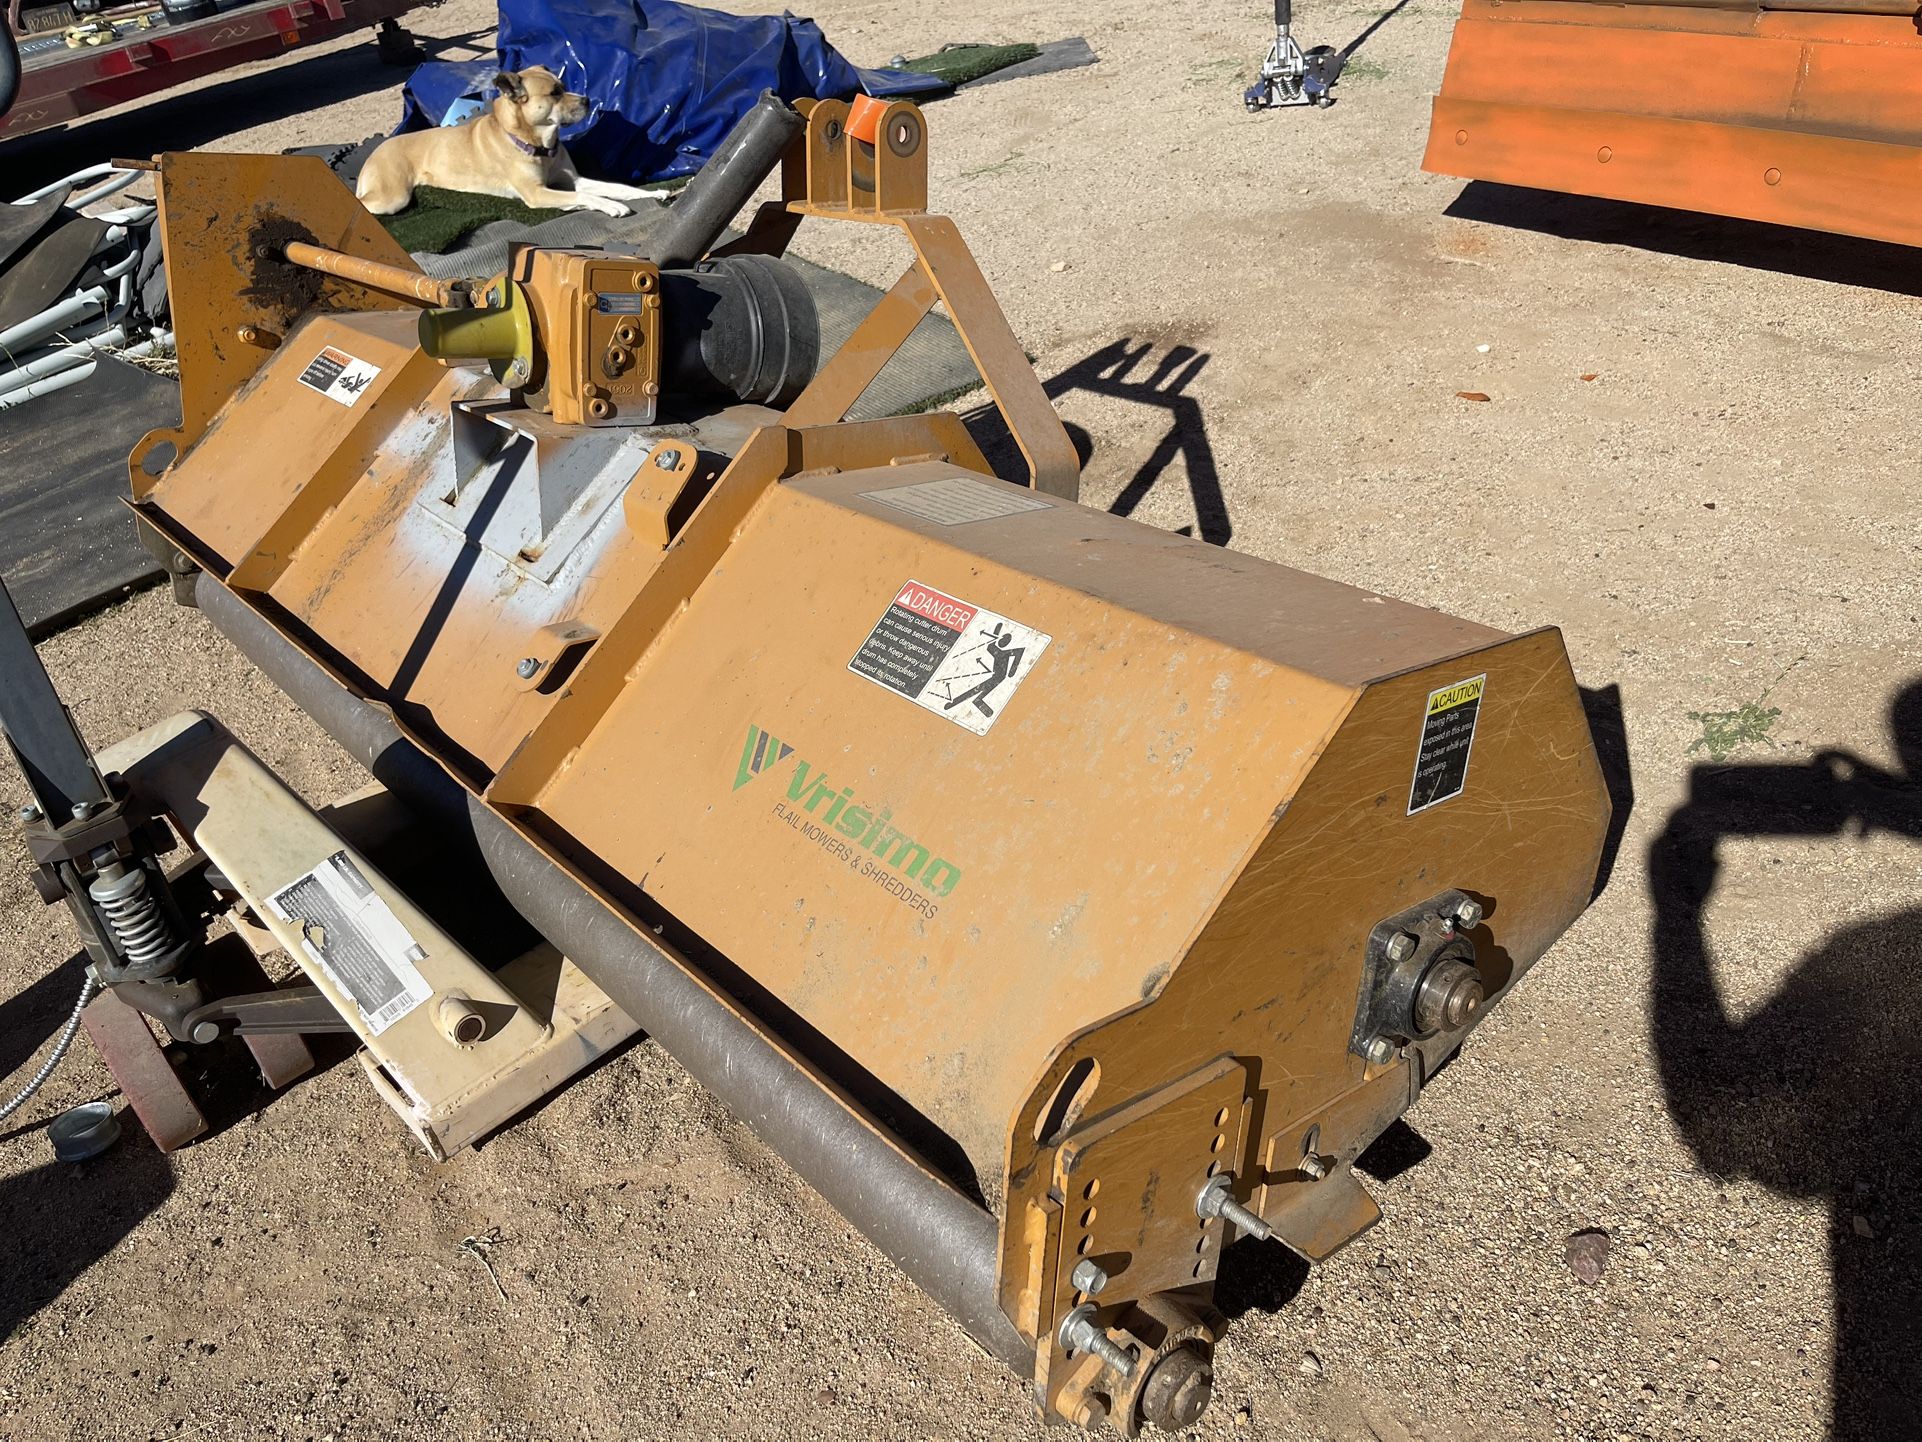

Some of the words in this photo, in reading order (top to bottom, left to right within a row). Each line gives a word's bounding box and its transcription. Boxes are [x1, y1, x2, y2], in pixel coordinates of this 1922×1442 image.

[890, 607, 914, 623] Rotating
[914, 618, 932, 629] cutter
[931, 625, 948, 636] drum
[911, 592, 970, 629] DANGER
[883, 618, 895, 627] can
[894, 623, 912, 634] cause
[912, 630, 933, 644] serious
[934, 640, 950, 653] injury
[883, 629, 899, 641] throw
[899, 637, 930, 657] dangerous
[854, 659, 878, 673] stopped
[884, 673, 906, 688] rotation.
[861, 648, 876, 659] drum
[876, 655, 887, 664] has
[888, 661, 918, 680] completely
[888, 646, 903, 659] Keep
[904, 656, 919, 667] away
[920, 661, 933, 672] until
[1439, 681, 1482, 707] CAUTION
[1424, 731, 1445, 746] exposed
[1450, 725, 1460, 735] this
[1426, 715, 1445, 730] Moving
[1421, 752, 1432, 763] Stay
[1432, 746, 1445, 757] clear
[786, 760, 961, 897] Vrisimo
[772, 802, 799, 829] FLAIL
[799, 821, 853, 862] MOWERS
[851, 856, 862, 870] &
[861, 862, 938, 919] SHREDDERS
